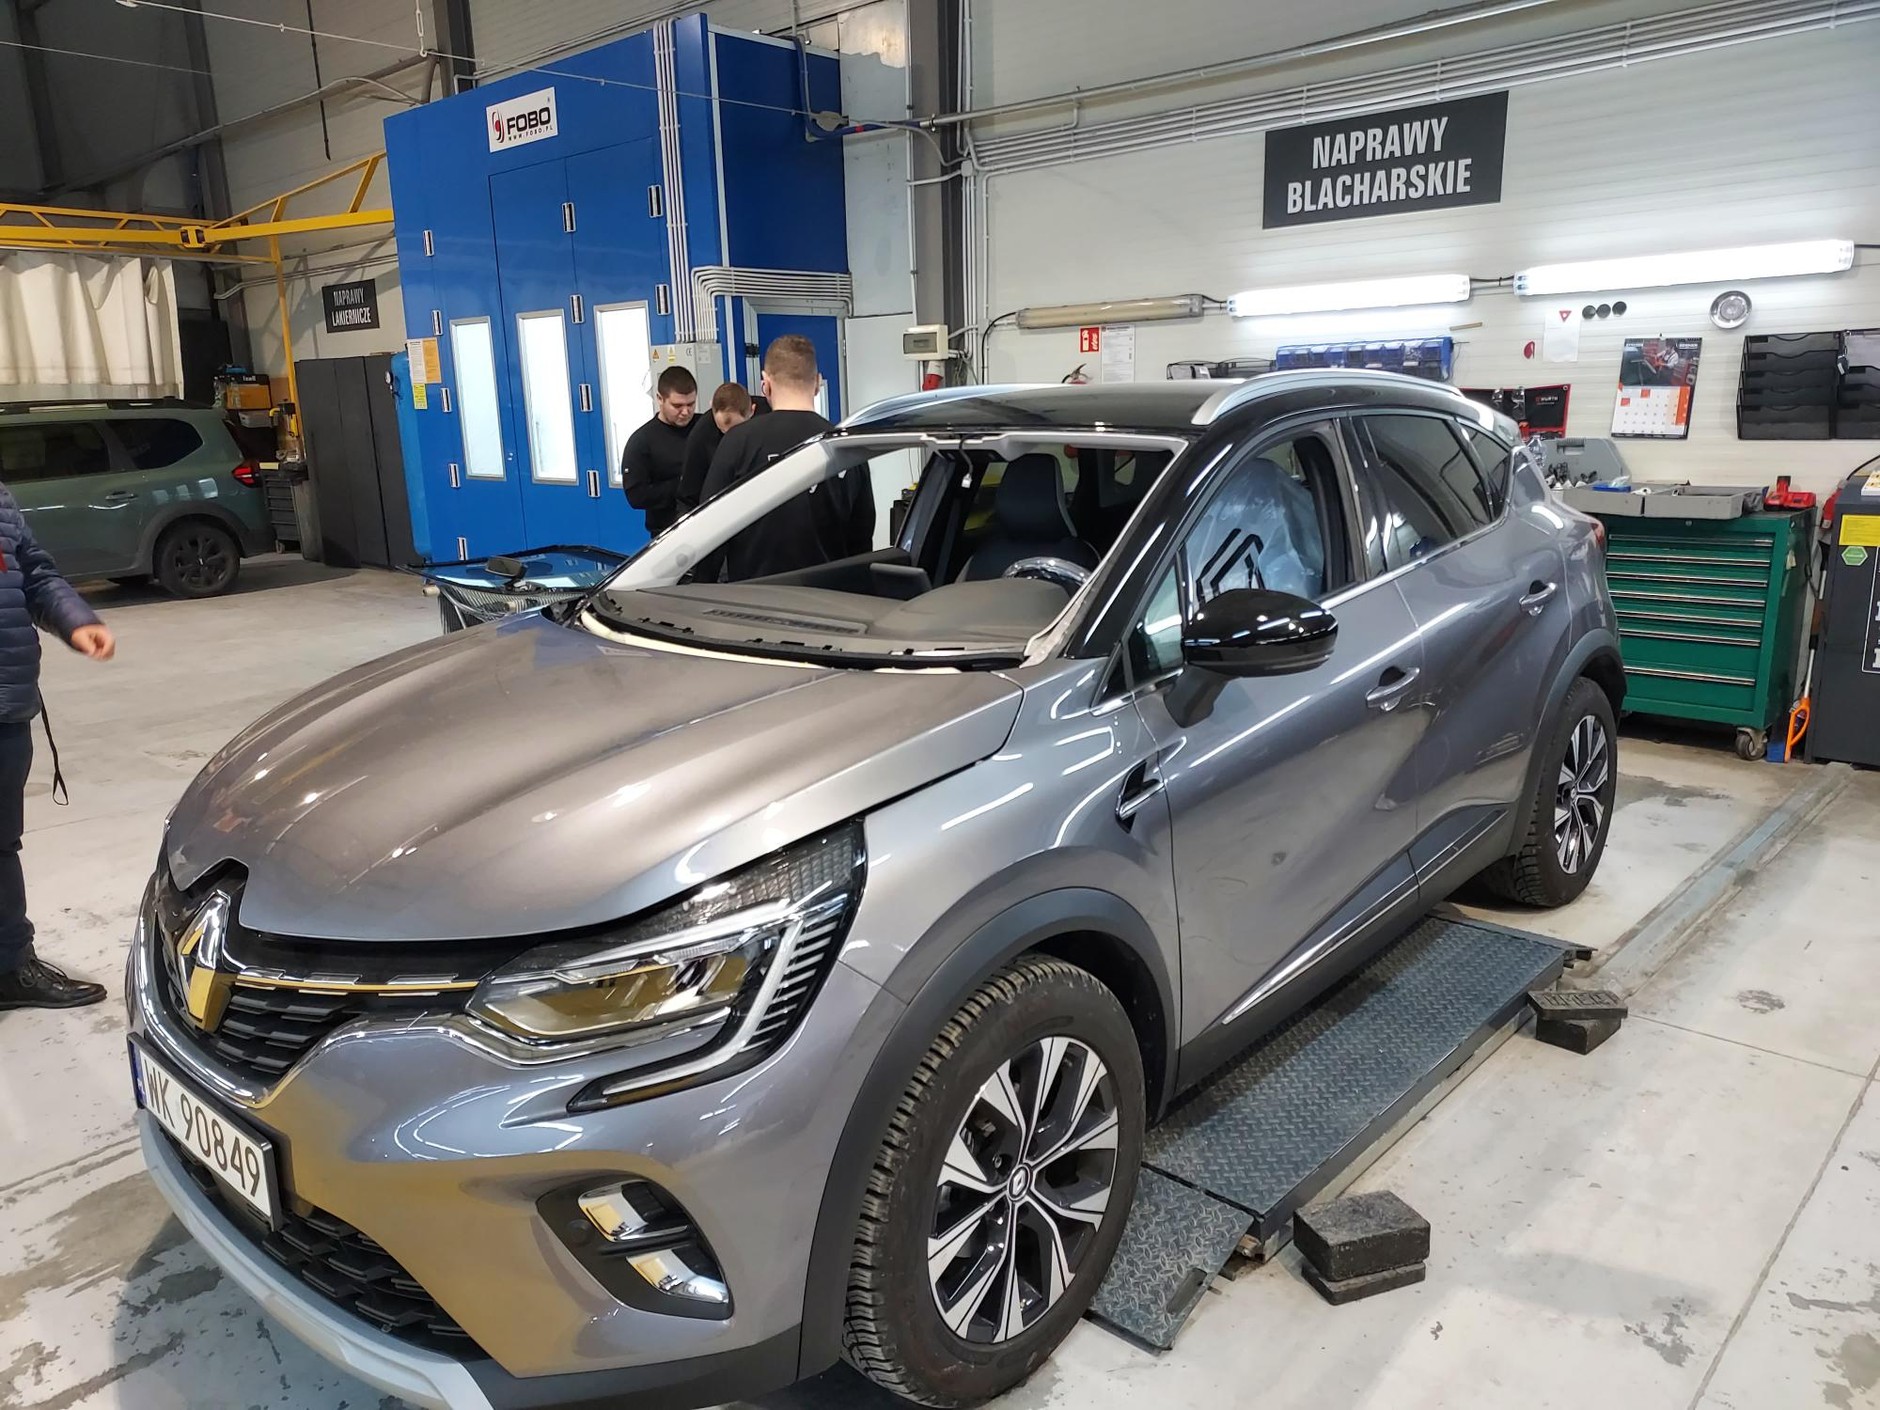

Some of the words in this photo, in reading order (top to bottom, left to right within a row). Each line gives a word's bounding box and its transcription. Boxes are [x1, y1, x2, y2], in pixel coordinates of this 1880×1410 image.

[506, 106, 551, 135] FOBO
[1312, 117, 1448, 169] NAPRAWY
[1287, 158, 1472, 214] BLACHARSKIE
[331, 307, 372, 327] LAKIERNICZE
[333, 287, 364, 307] NAPRAWY
[144, 1059, 176, 1129] WK
[180, 1093, 261, 1197] 90849
